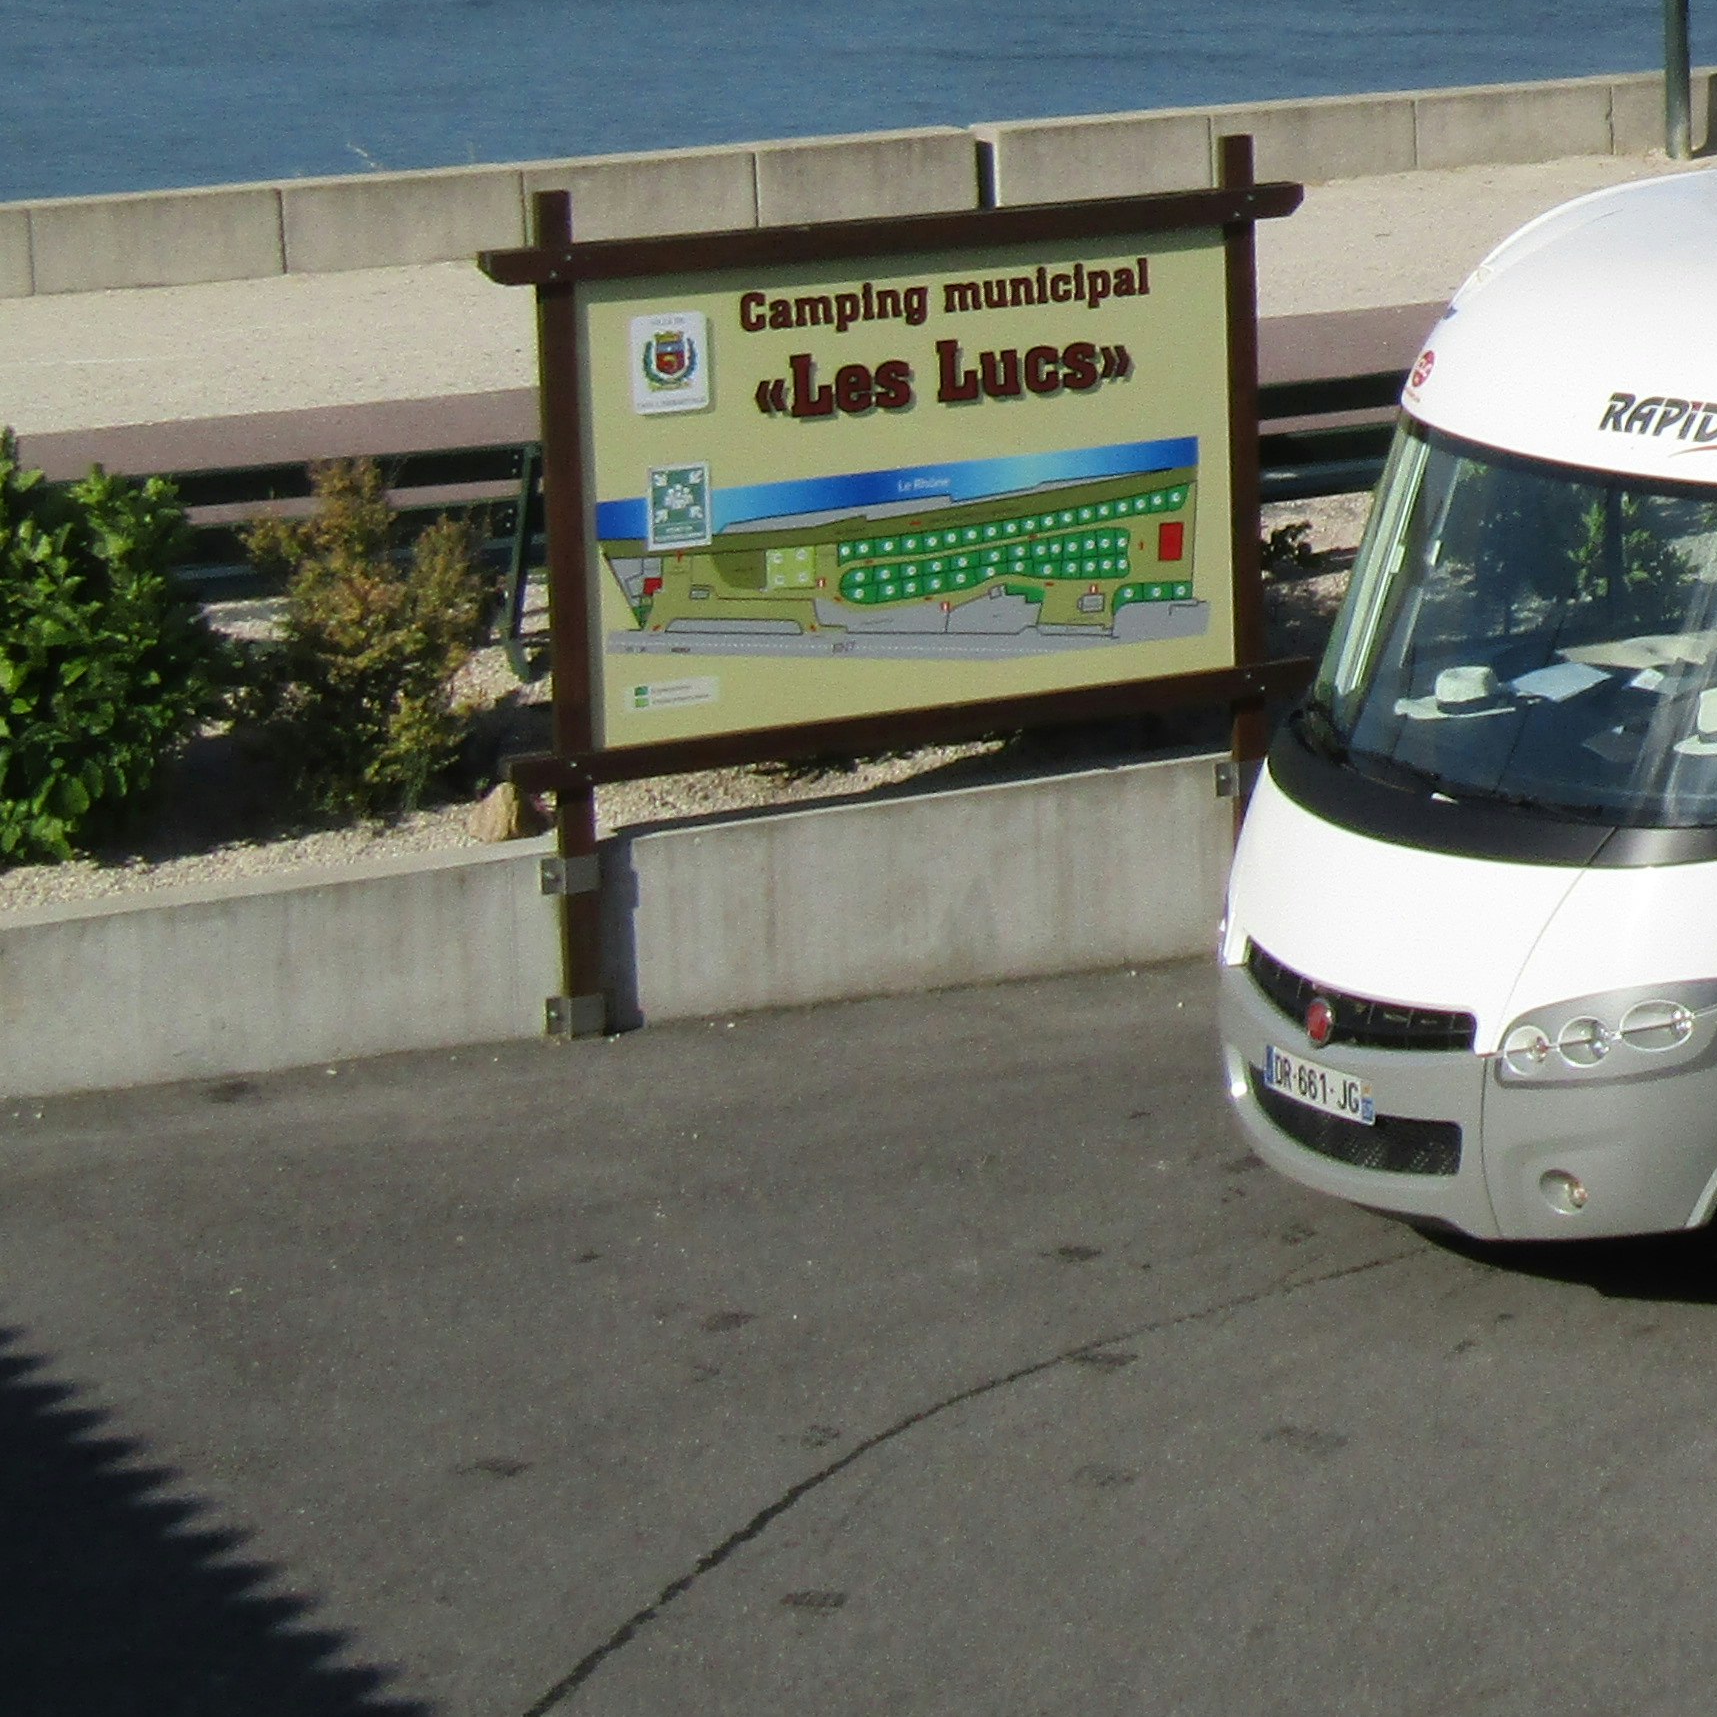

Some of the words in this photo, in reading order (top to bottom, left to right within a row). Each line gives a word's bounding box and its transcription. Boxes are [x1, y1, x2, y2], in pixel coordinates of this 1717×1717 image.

[740, 282, 929, 332] Camping
[943, 257, 1151, 312] municipal
[755, 353, 912, 418] «Les
[935, 339, 1133, 403] Lucs»
